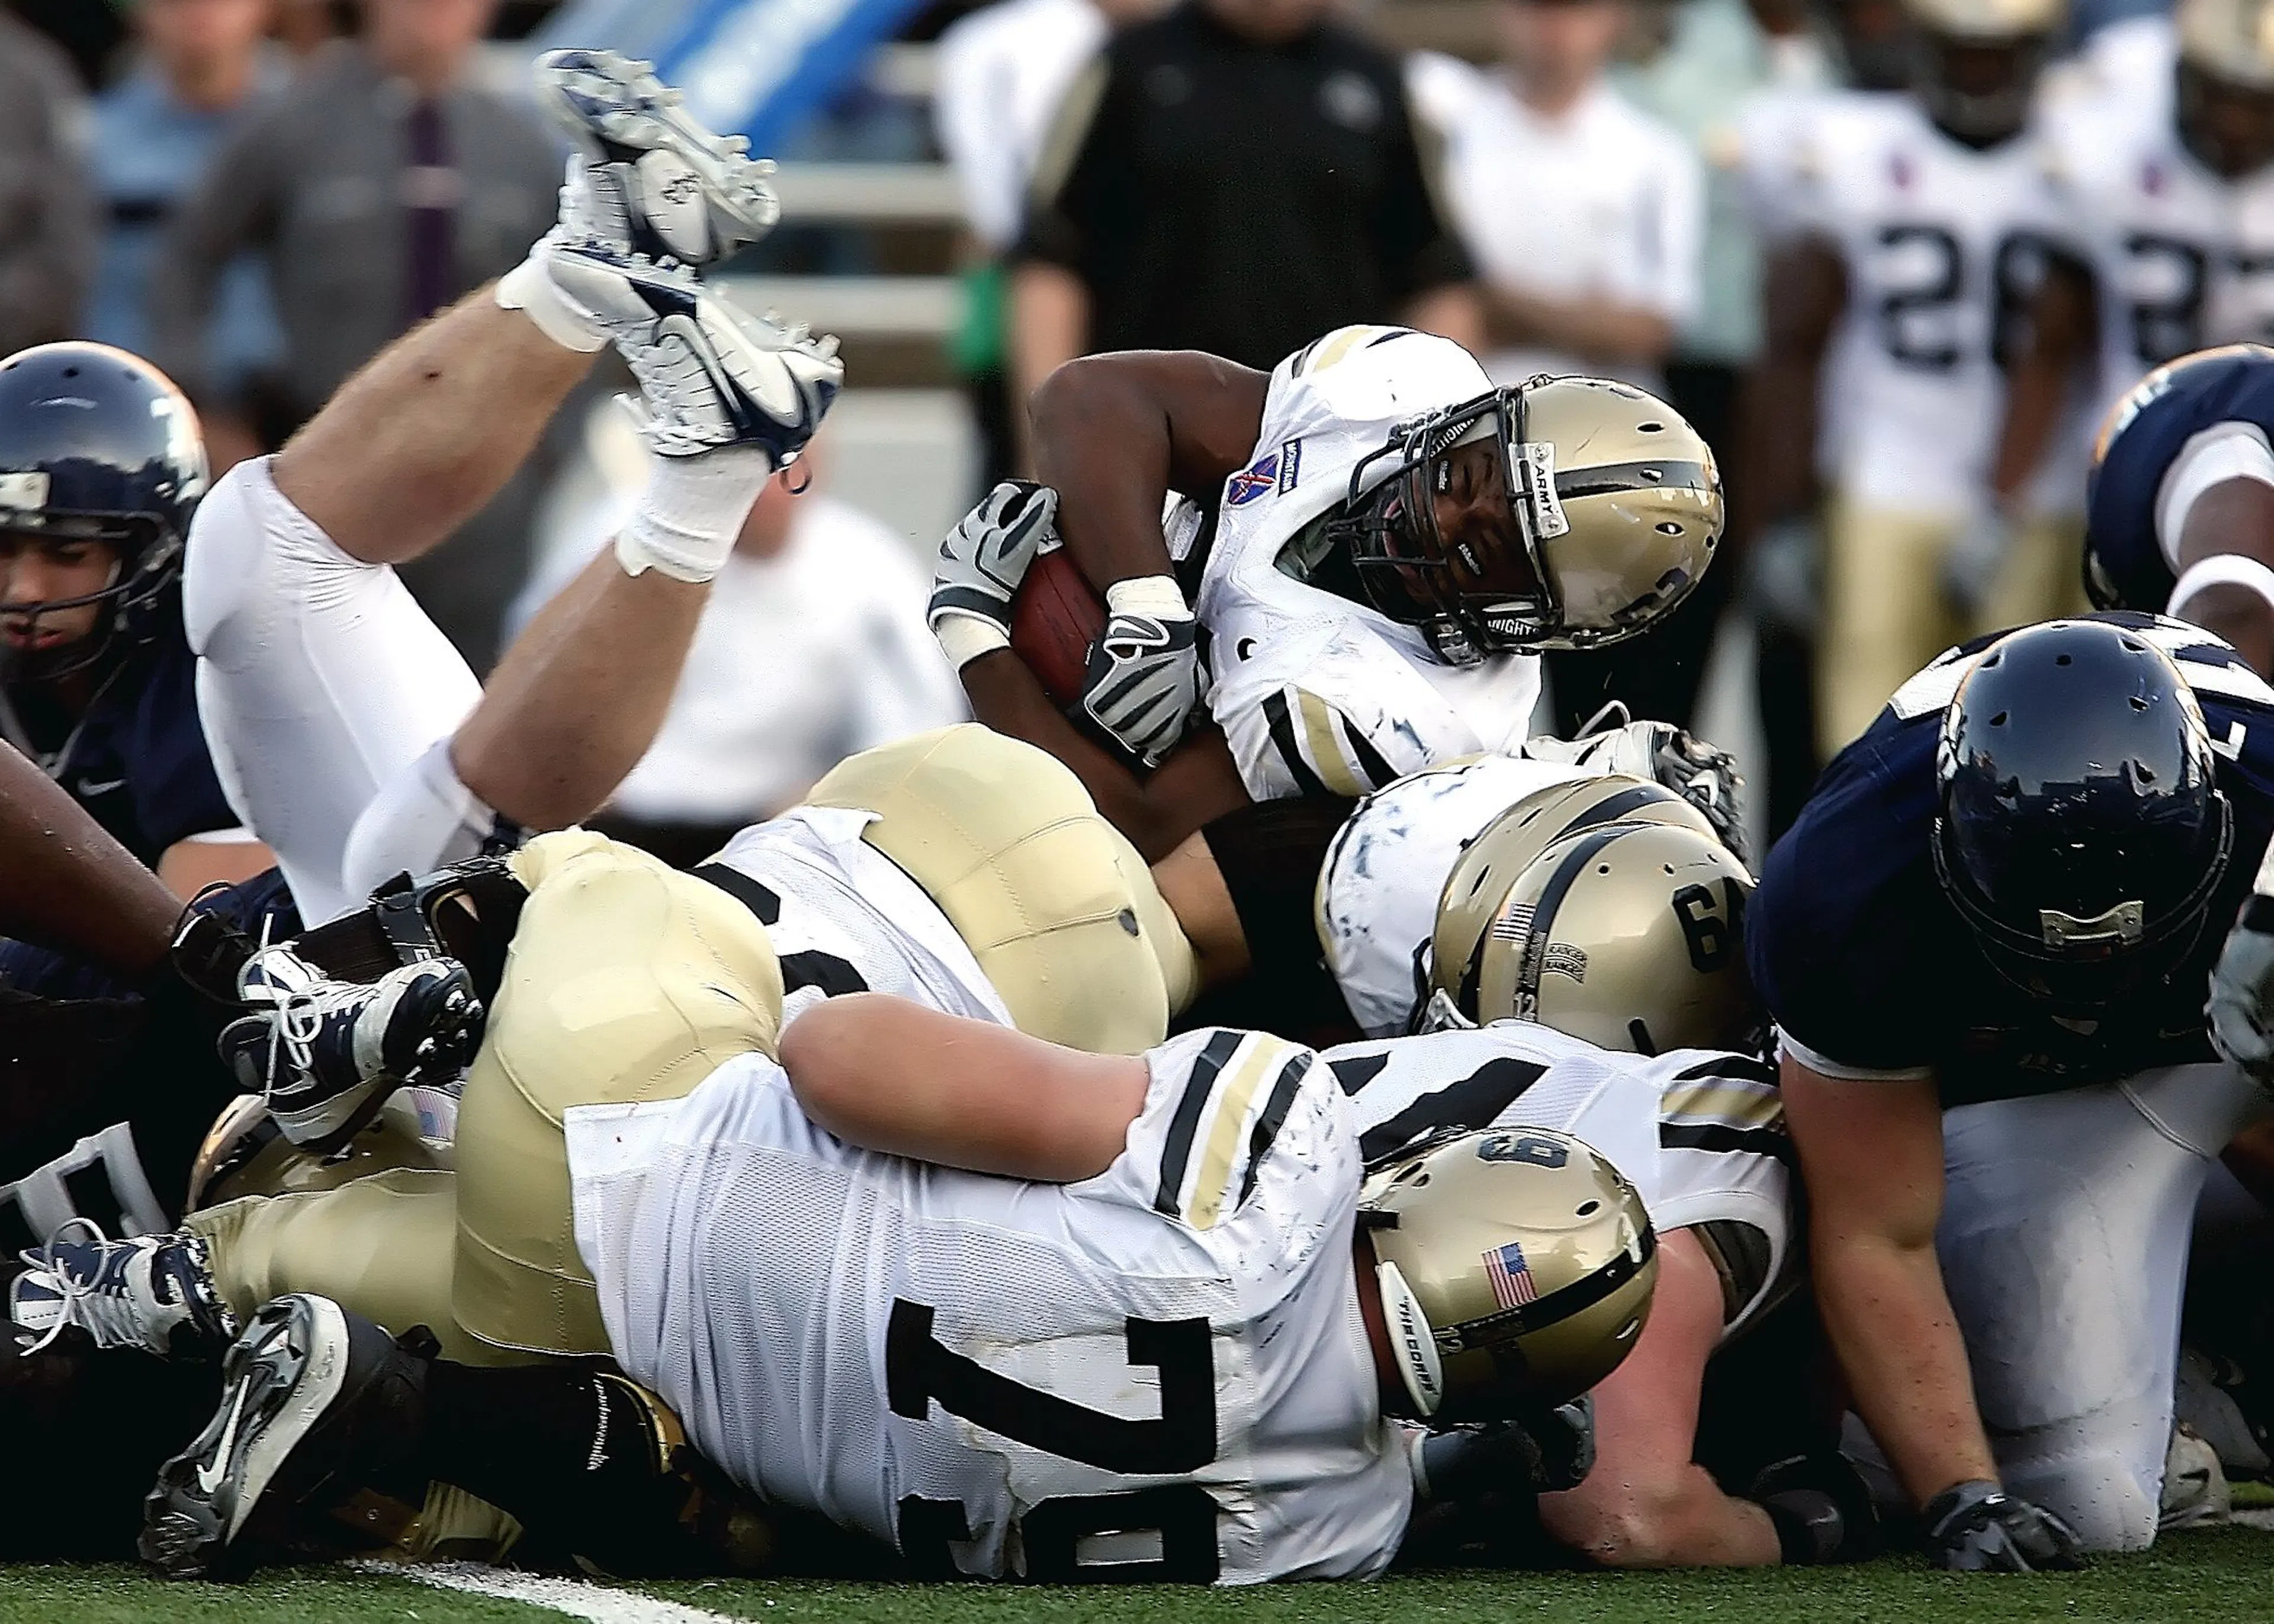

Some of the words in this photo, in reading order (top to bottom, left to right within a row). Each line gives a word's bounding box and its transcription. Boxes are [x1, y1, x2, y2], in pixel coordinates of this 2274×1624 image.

[1536, 465, 1554, 516] ARMY
[1513, 991, 1536, 1022] 12
[887, 1297, 1220, 1584] 79
